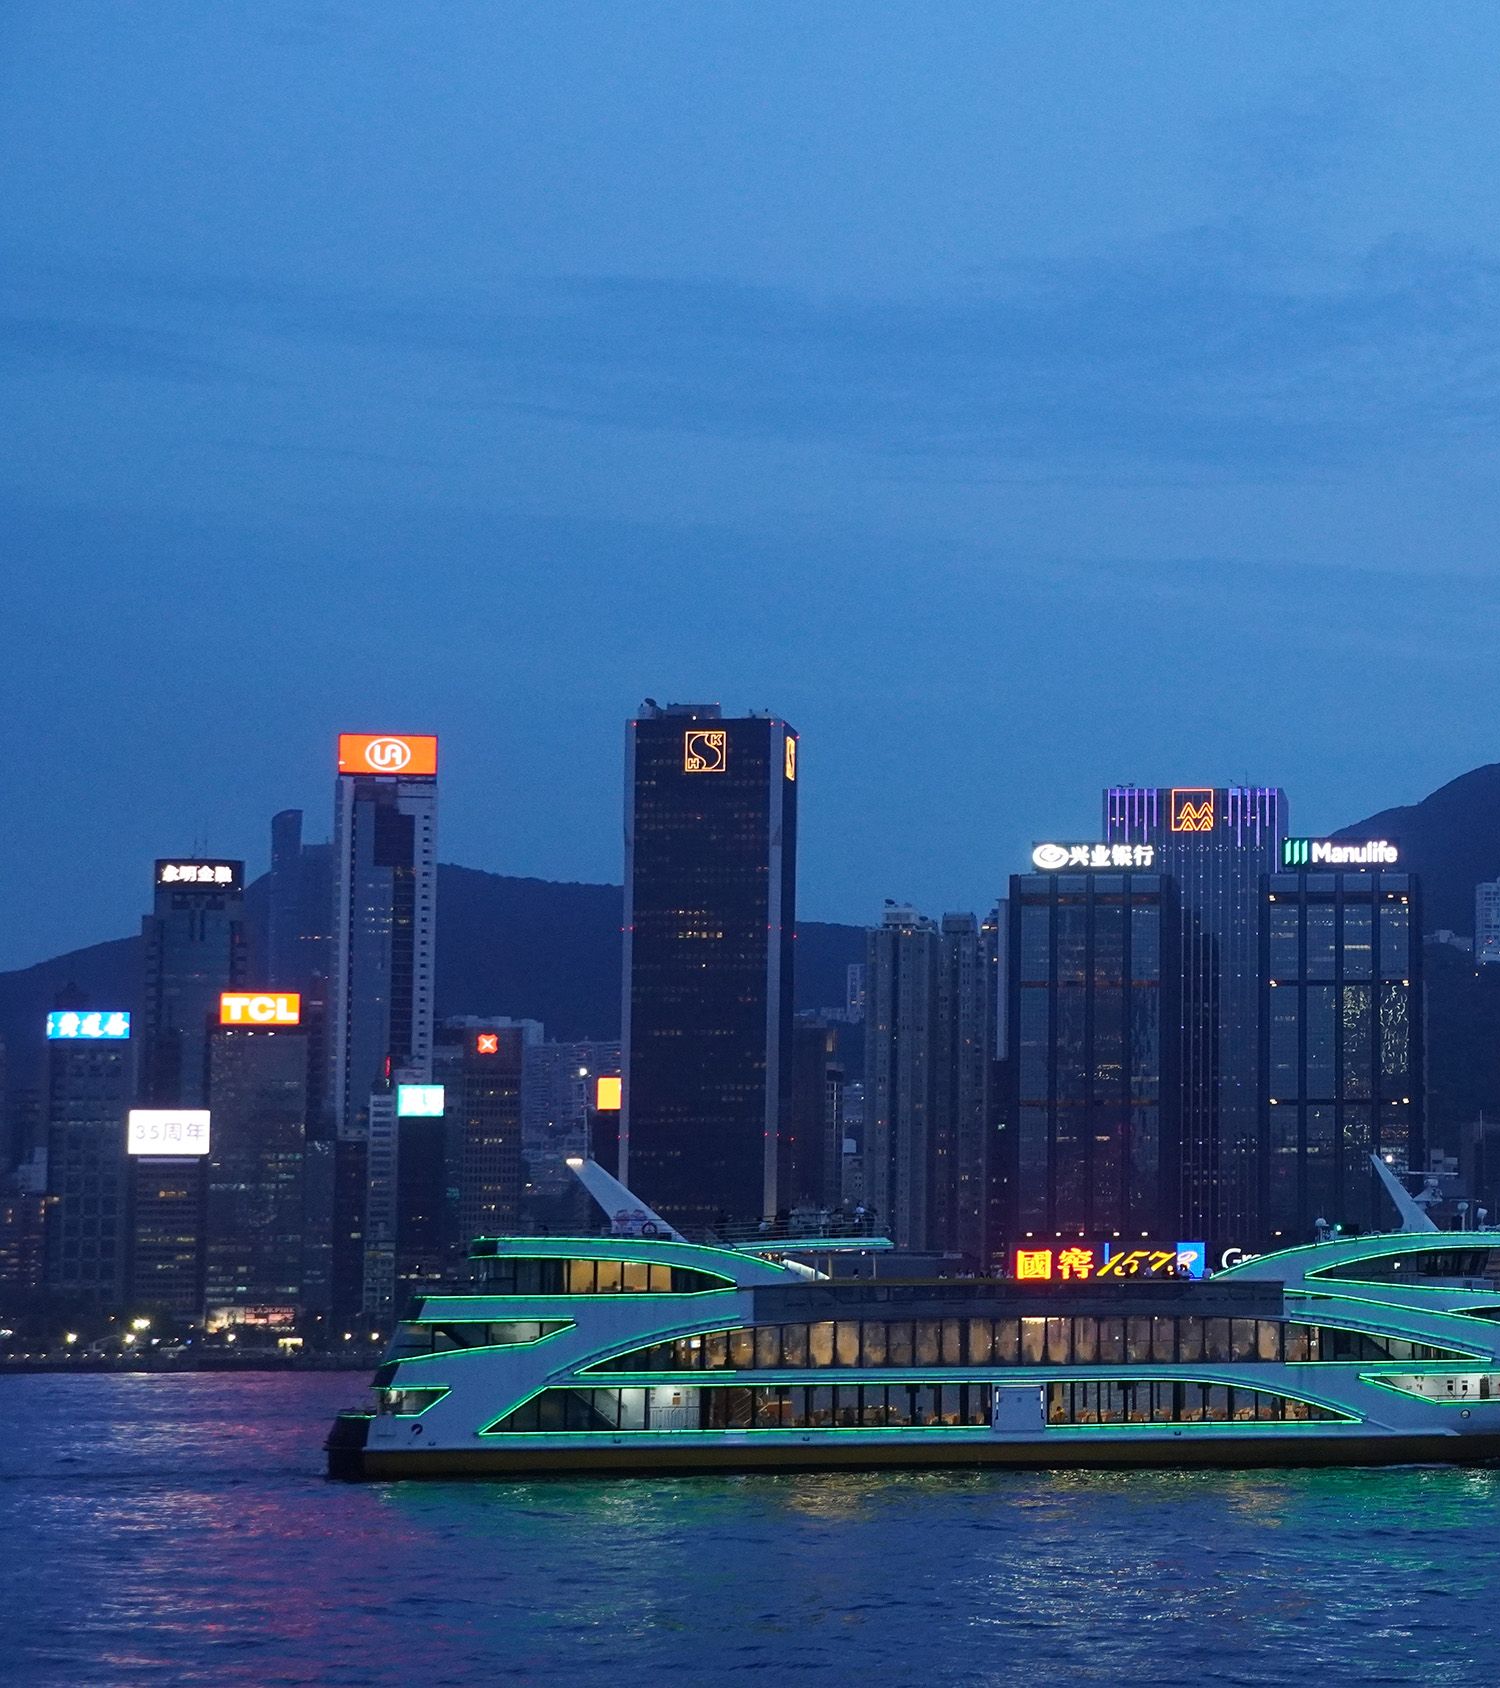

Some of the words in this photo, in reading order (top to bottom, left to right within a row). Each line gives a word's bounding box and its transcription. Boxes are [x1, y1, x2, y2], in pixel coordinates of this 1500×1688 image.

[1068, 844, 1154, 867] 兴业银行
[1311, 840, 1398, 863] Manulife
[222, 995, 299, 1021] TCL
